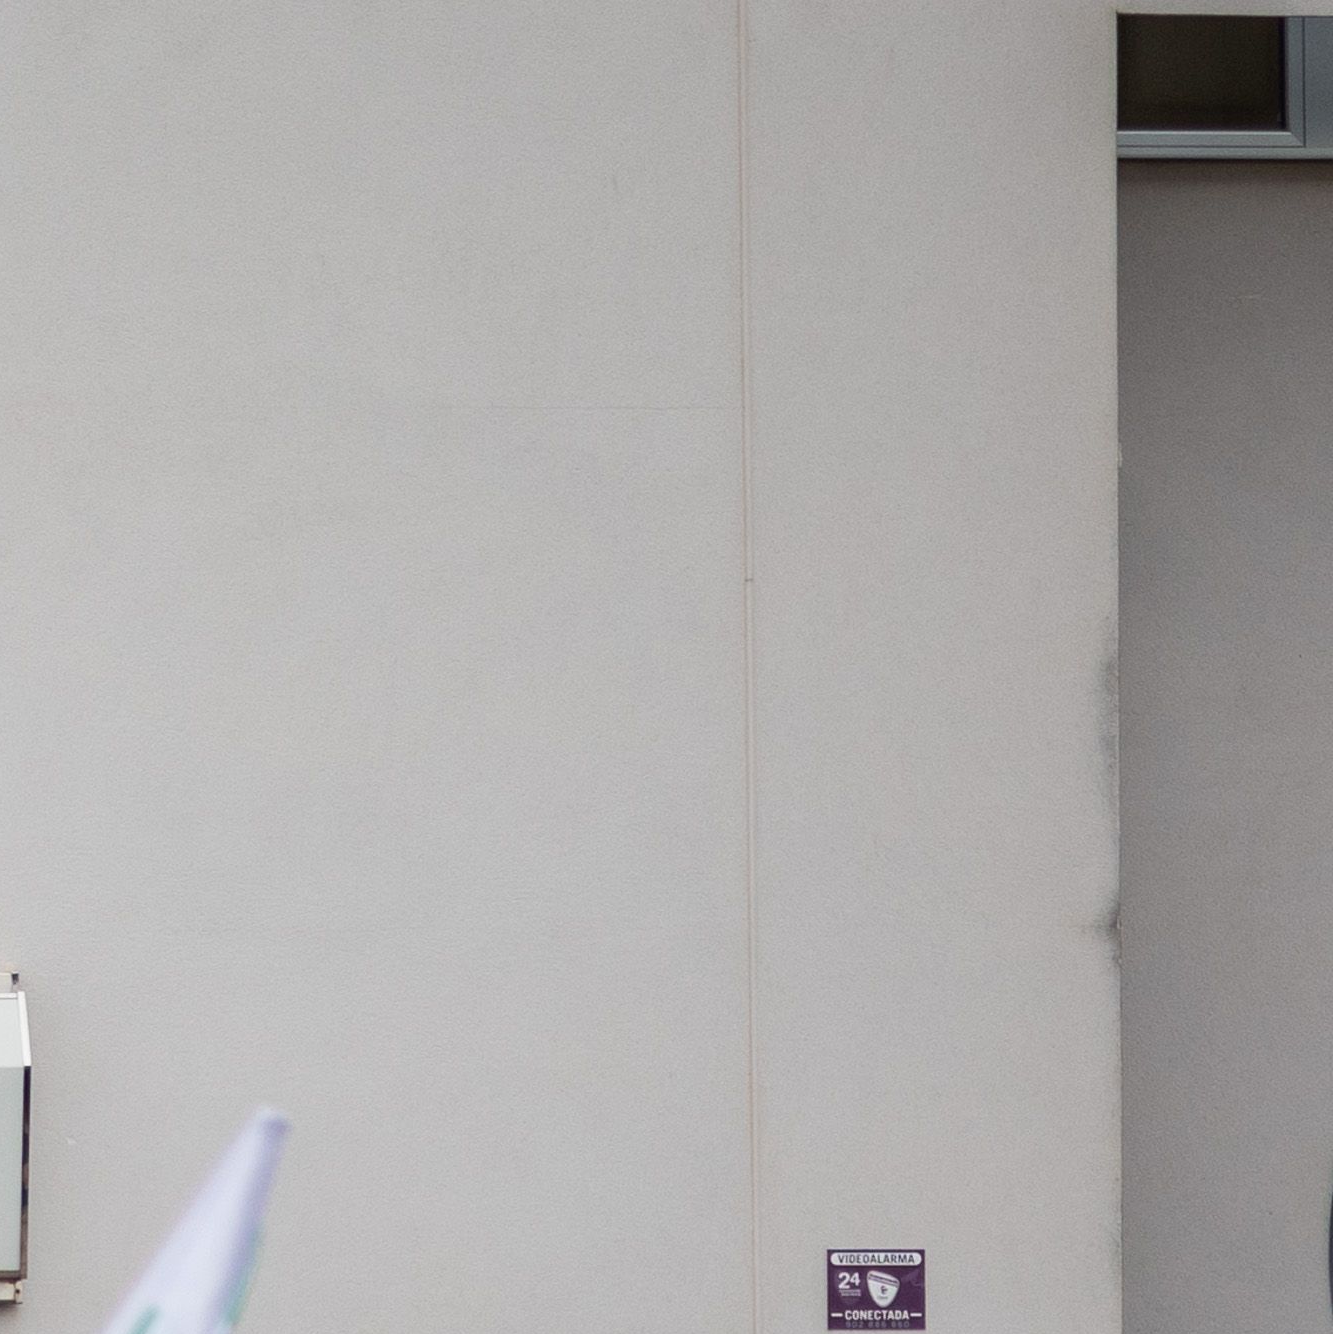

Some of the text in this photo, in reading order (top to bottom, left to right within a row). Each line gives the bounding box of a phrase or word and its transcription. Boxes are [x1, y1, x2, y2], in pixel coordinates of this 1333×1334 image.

[837, 1254, 915, 1264] VIDEOALARMA
[838, 1271, 861, 1289] 24
[844, 1309, 910, 1320] CONECTADA
